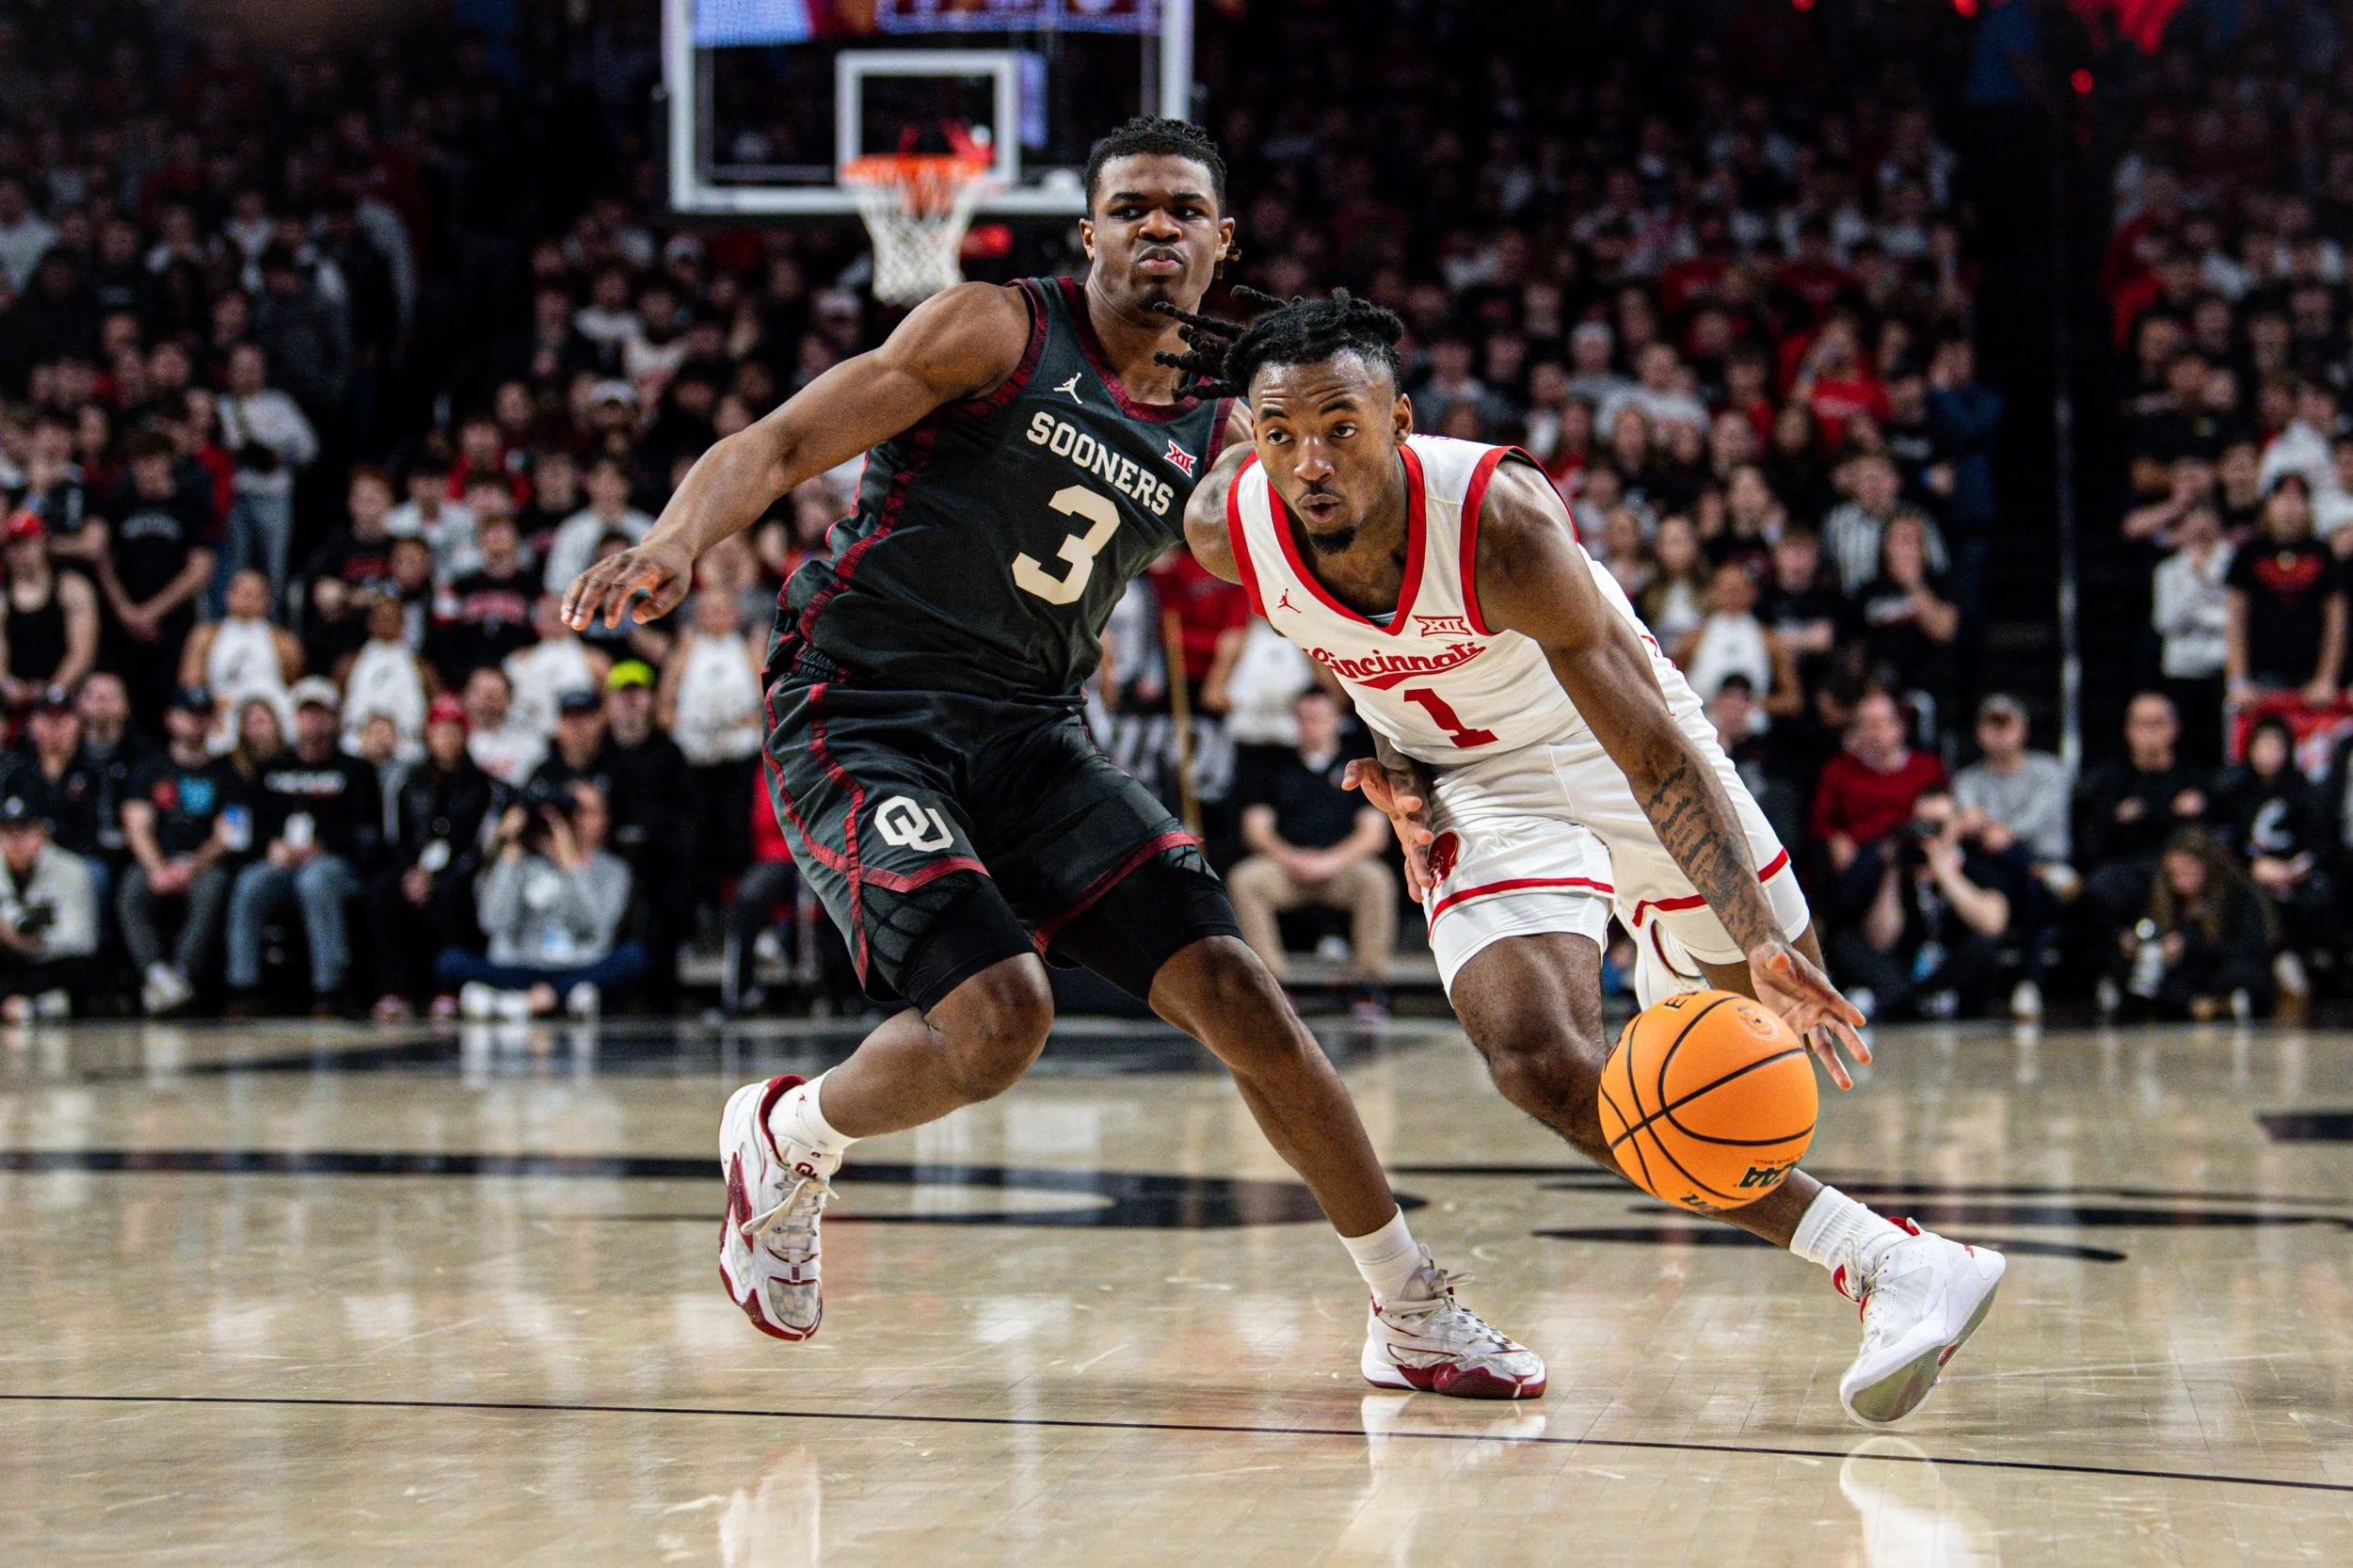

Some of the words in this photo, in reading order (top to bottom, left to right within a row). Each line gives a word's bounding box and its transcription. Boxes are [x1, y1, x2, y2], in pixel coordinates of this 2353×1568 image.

[1026, 411, 1175, 516] SOONERS
[1167, 442, 1194, 474] XII
[1012, 485, 1120, 605] 3
[1413, 616, 1472, 637] XII
[1304, 642, 1487, 684] Cincinnati
[1403, 688, 1499, 748] 1
[873, 795, 954, 853] OU
